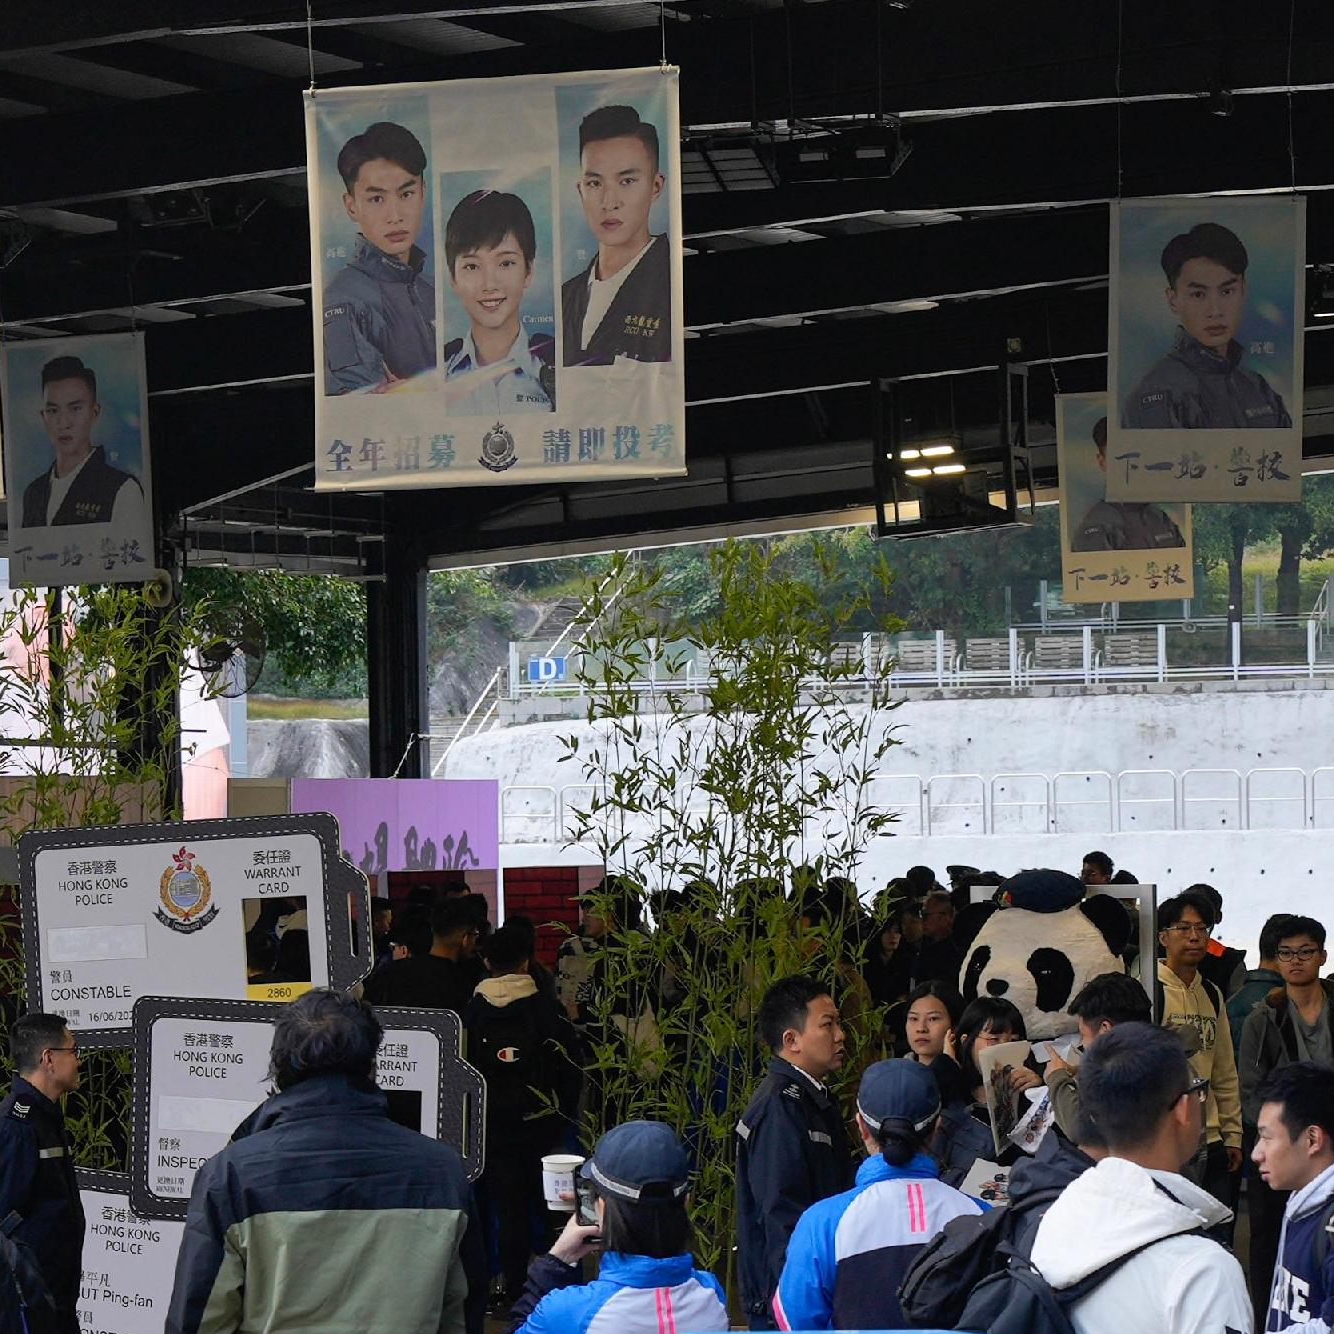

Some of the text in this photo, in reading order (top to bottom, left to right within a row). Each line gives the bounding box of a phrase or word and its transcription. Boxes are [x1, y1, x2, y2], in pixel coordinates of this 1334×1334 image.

[543, 424, 676, 464] 請即投考
[326, 434, 457, 473] 全年招募
[252, 850, 292, 866] 委任證
[67, 860, 117, 876] 香港警察
[244, 865, 301, 880] WARRANT
[58, 877, 128, 892] HONG KONG
[258, 882, 289, 895] CARD
[75, 893, 113, 906] POLICE
[49, 970, 73, 984] 警員
[50, 985, 132, 1002] CONSTABLE
[267, 987, 292, 999] 2860
[183, 1033, 234, 1049] 香港警察
[173, 1050, 244, 1065] HONG KONG
[189, 1066, 227, 1079] POLICE
[91, 1223, 160, 1242] HONG KONG
[105, 1240, 144, 1254] POLICE
[102, 1289, 153, 1308] Ping-fan
